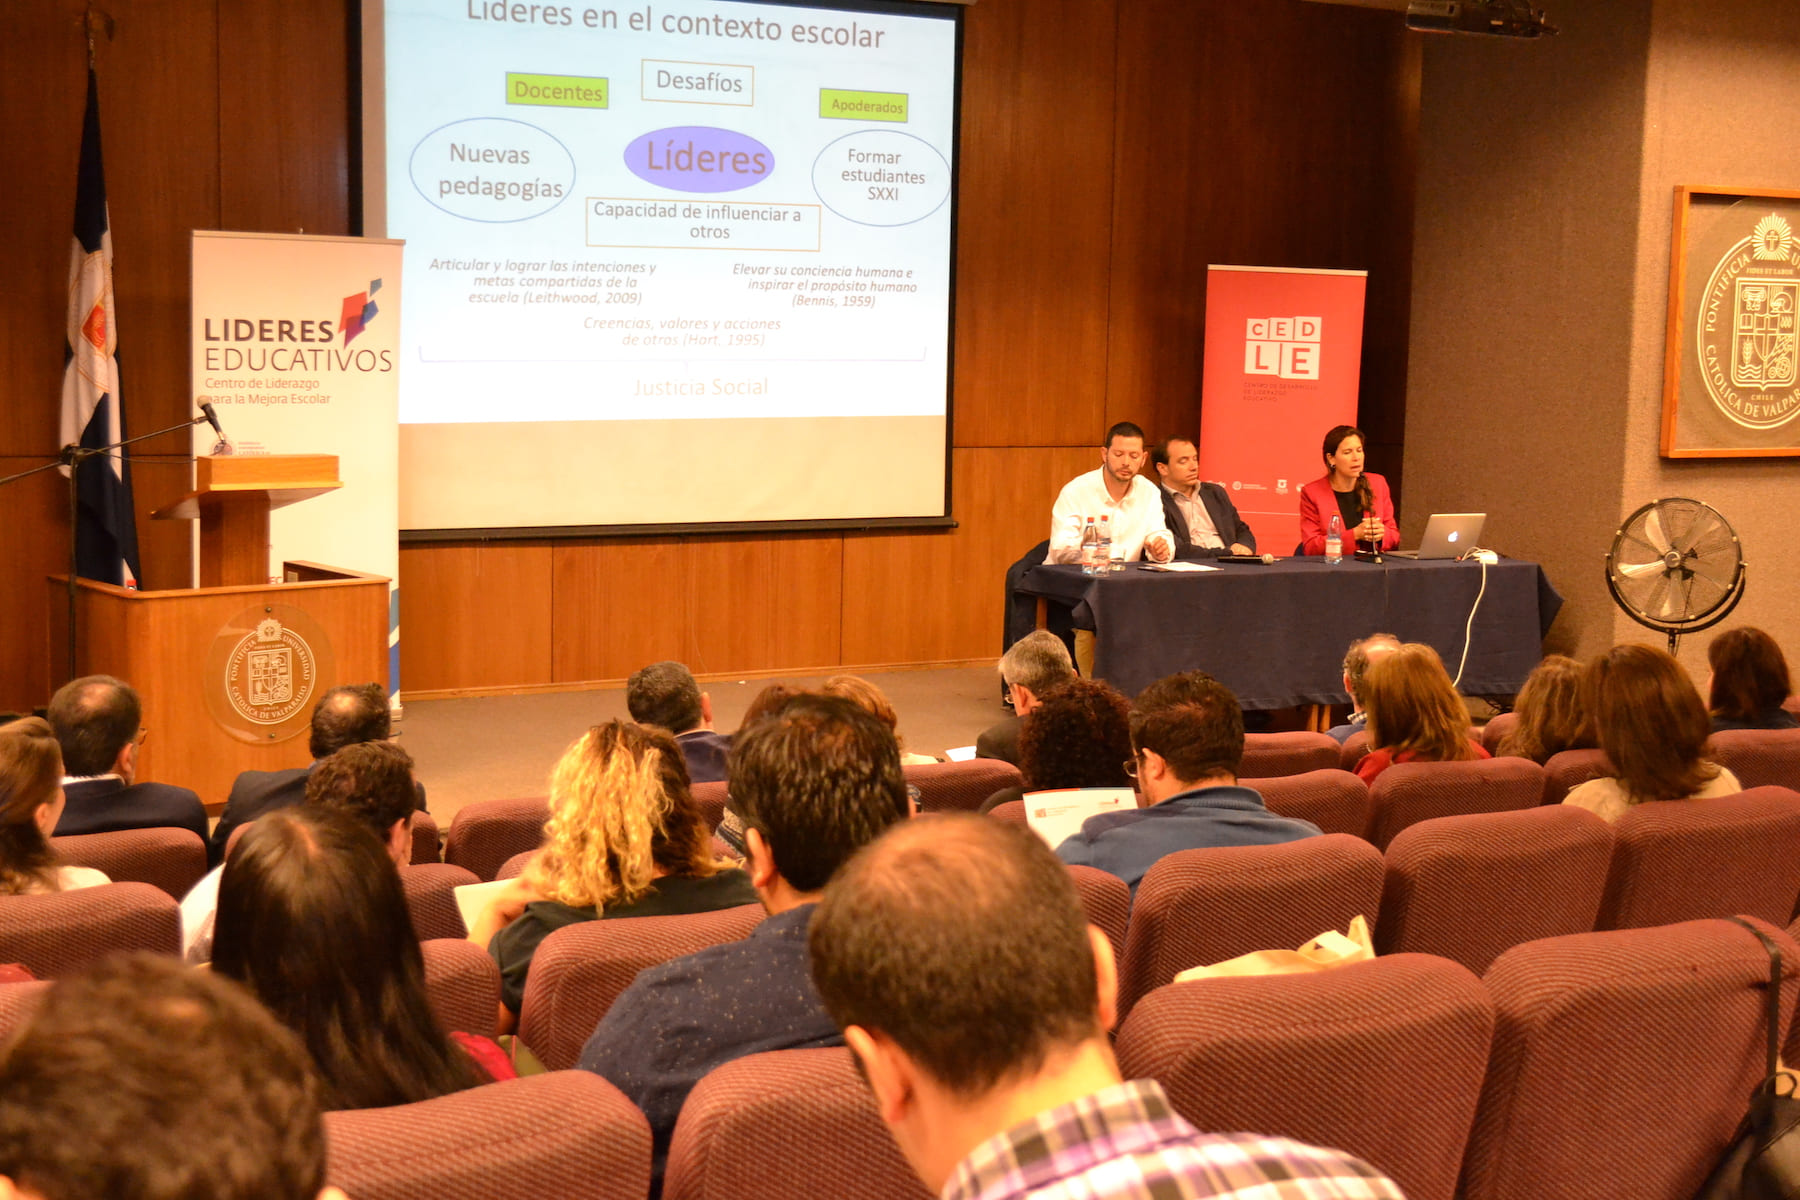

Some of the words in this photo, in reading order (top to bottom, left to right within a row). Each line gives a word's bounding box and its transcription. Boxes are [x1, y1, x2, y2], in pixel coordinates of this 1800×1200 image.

[582, 8, 618, 30] en
[629, 5, 652, 32] el
[661, 14, 782, 40] contexto
[791, 21, 885, 49] escolar
[656, 69, 743, 94] Desafíos
[514, 80, 603, 103] Docentes
[831, 98, 904, 115] Apoderados
[450, 142, 531, 165] Nuevas
[647, 139, 767, 175] Líderes
[848, 148, 902, 165] Formar
[841, 168, 926, 185] estudiantes
[439, 175, 564, 202] pedagogías
[867, 187, 900, 201] SXXI
[594, 200, 677, 220] Capacidad
[682, 203, 703, 219] de
[706, 204, 789, 222] influenciar
[792, 208, 802, 221] a
[690, 226, 731, 240] otros
[428, 257, 491, 272] Articular
[493, 261, 502, 274] y
[504, 259, 547, 275] lograr
[549, 259, 569, 272] las
[571, 260, 646, 274] intenciones
[648, 263, 657, 276] y
[732, 263, 771, 276] Elevar
[774, 266, 787, 276] su
[790, 264, 852, 278] conciencia
[855, 265, 903, 279] humana
[906, 269, 913, 279] e
[473, 276, 515, 288] metas
[519, 275, 603, 290] compartidas
[606, 275, 622, 289] de
[625, 276, 638, 288] la
[748, 278, 795, 293] inspirar
[797, 279, 808, 291] el
[810, 279, 867, 294] propósito
[870, 280, 918, 293] humano
[468, 292, 519, 304] escuela
[523, 291, 601, 306] (Leithwood,
[605, 291, 643, 306] 2009)
[1705, 252, 1751, 332] PONTIFICIA
[791, 294, 838, 309] (Bennis,
[842, 295, 876, 310] 1959)
[204, 318, 334, 343] LIDERES
[583, 316, 655, 331] Creencias,
[660, 316, 709, 330] valores
[712, 319, 721, 331] y
[723, 317, 782, 330] acciones
[1252, 321, 1315, 337] CED
[622, 333, 639, 346] de
[205, 347, 393, 373] EDUCATIVOS
[1255, 345, 1311, 374] LE
[205, 377, 246, 389] Centro
[247, 377, 263, 389] de
[265, 377, 320, 391] Liderazgo
[633, 378, 705, 397] Justicia
[711, 377, 769, 396] Social
[234, 393, 246, 405] la
[248, 393, 289, 407] Mejora
[291, 393, 332, 405] Escolar
[1743, 402, 1760, 418] DE
[231, 640, 257, 682] PONTIFICIA
[283, 634, 310, 681] UNIVERSIDAD
[260, 711, 269, 719] DE
